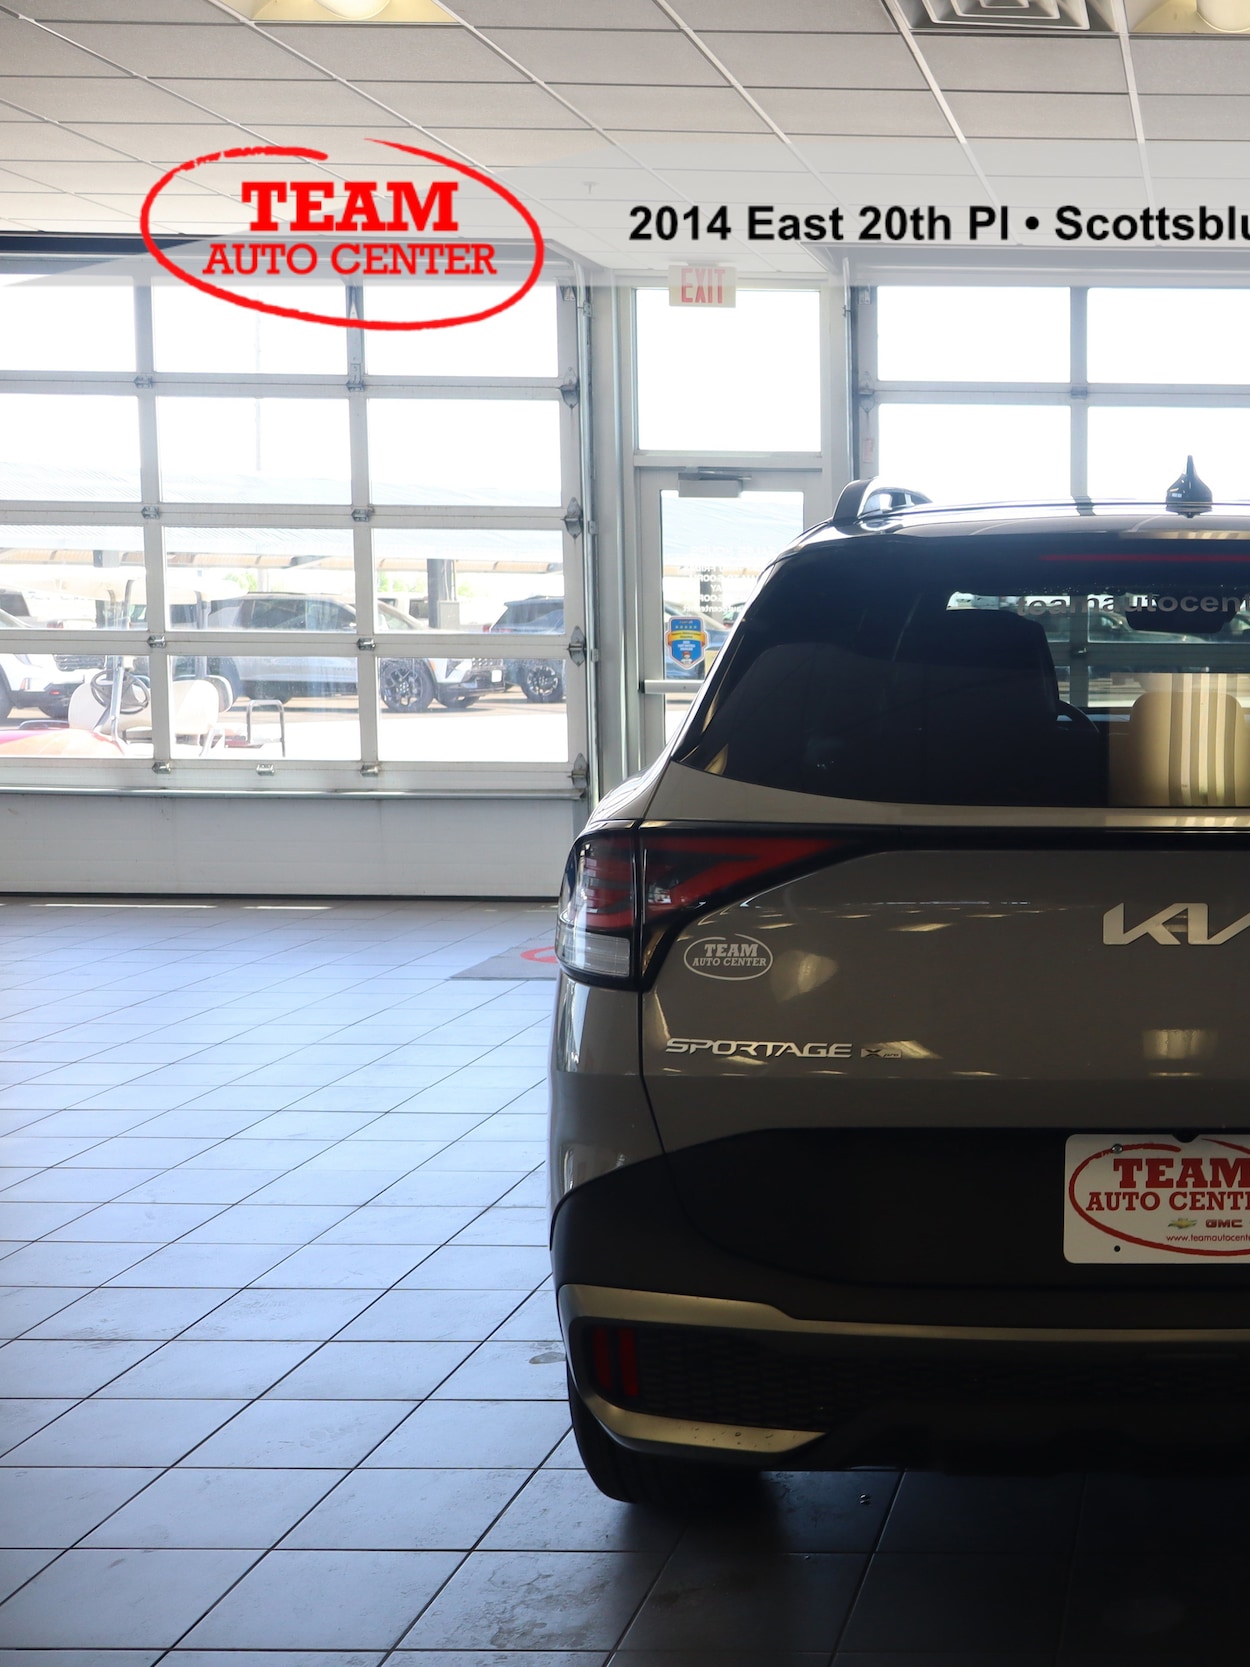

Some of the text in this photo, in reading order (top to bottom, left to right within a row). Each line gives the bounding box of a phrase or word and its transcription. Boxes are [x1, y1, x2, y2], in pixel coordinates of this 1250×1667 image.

[681, 267, 726, 304] EXIT
[704, 944, 759, 957] TEAM
[692, 957, 767, 967] AUTO CENTER
[665, 1037, 852, 1058] SPORTAGE
[1086, 1192, 1161, 1211] AUTO
[1205, 1219, 1243, 1228] GMC
